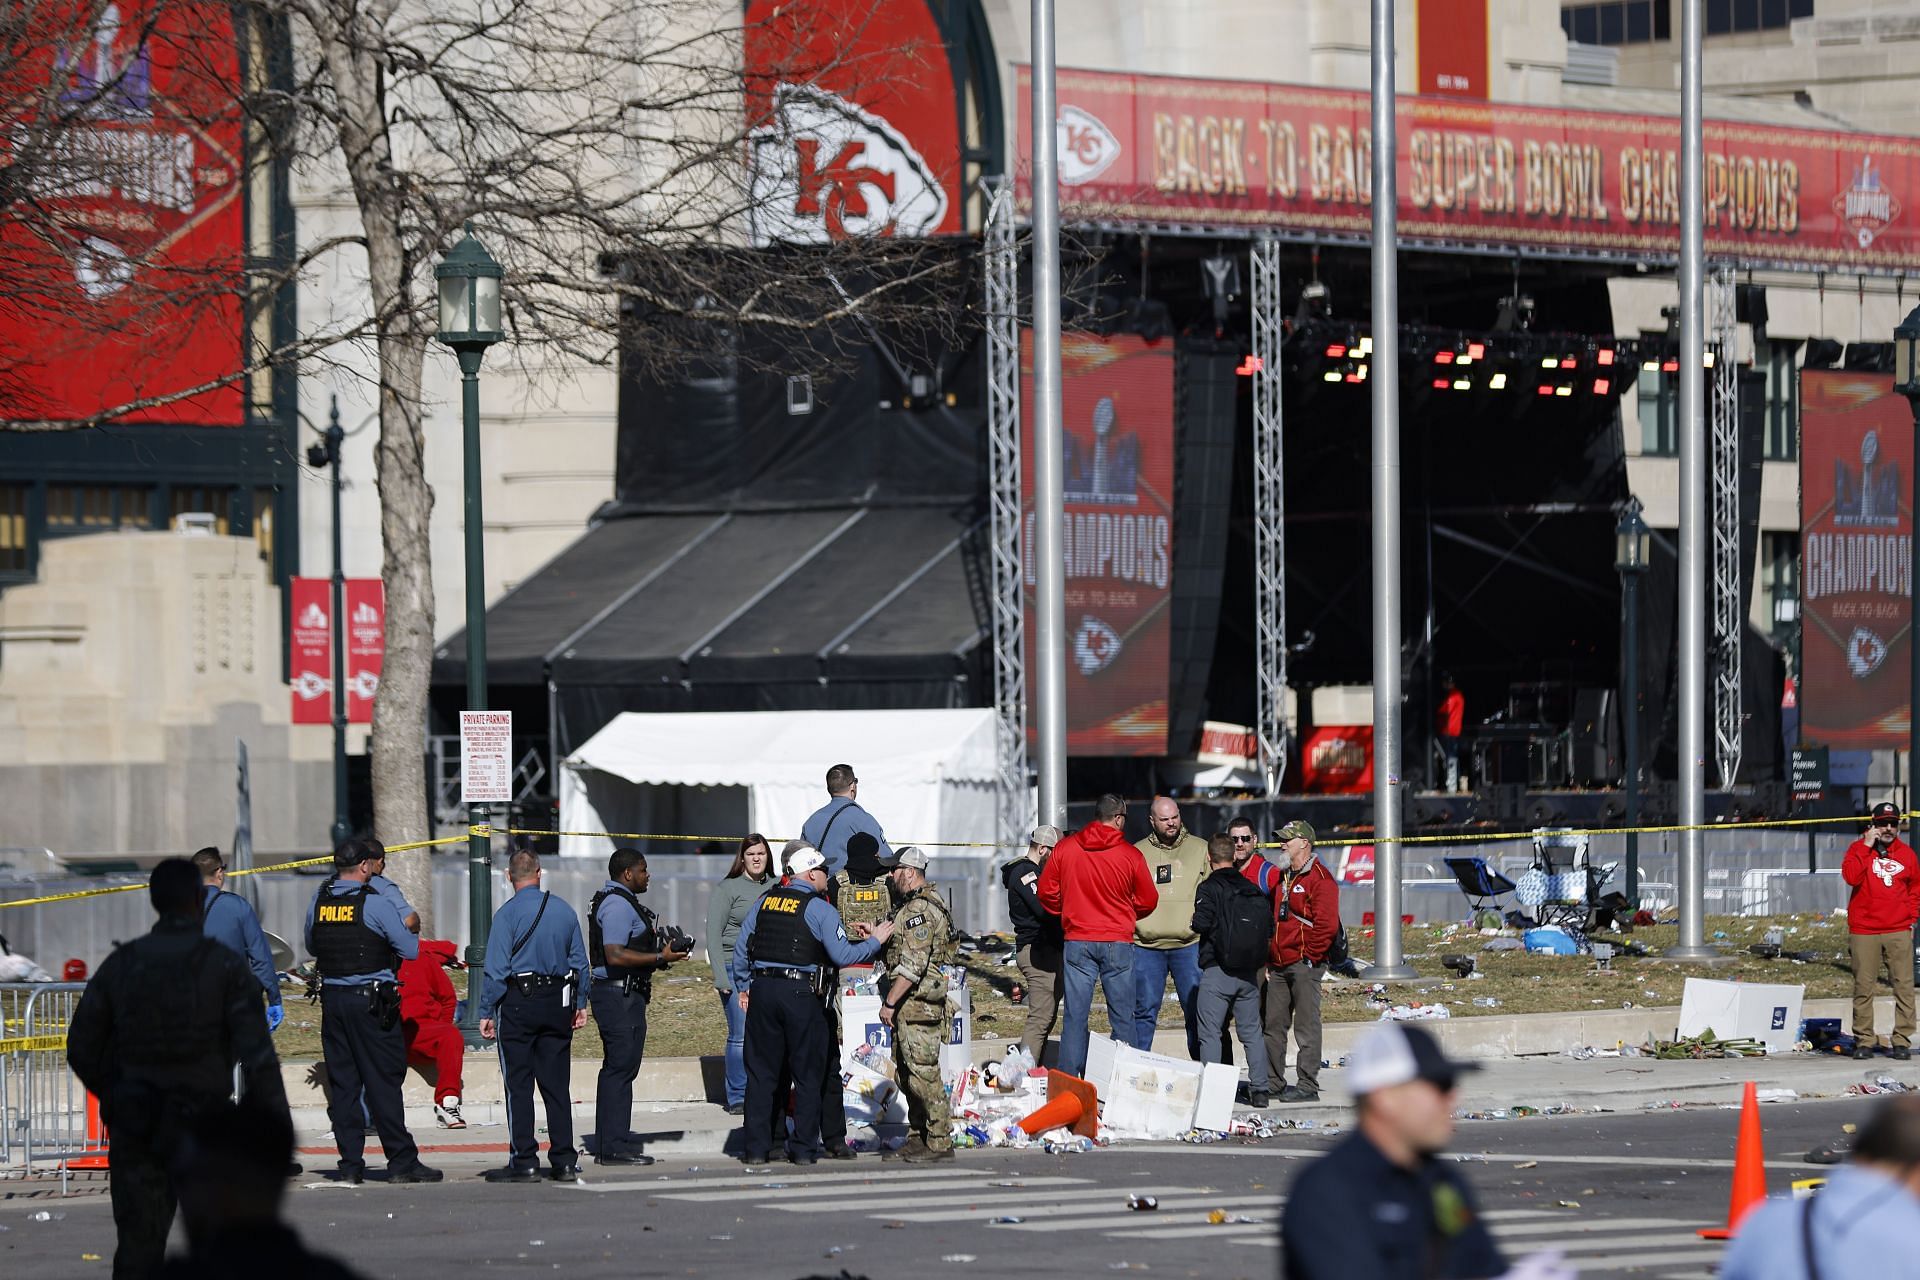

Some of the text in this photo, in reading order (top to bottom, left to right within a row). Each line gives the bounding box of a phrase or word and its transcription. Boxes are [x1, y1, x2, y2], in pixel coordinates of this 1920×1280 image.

[1309, 122, 1372, 207] BAC
[1409, 129, 1516, 215] SUPER
[1523, 138, 1609, 221] BOWL
[1619, 145, 1799, 233] CHAPIONS
[1025, 511, 1169, 590] CAMPIONS
[1806, 532, 1913, 601] CHAMPION
[463, 714, 509, 725] PRIVATE PARKING
[855, 890, 879, 901] FBI
[319, 905, 354, 922] POLICE
[762, 896, 801, 914] POLICE
[909, 915, 923, 928] FBI
